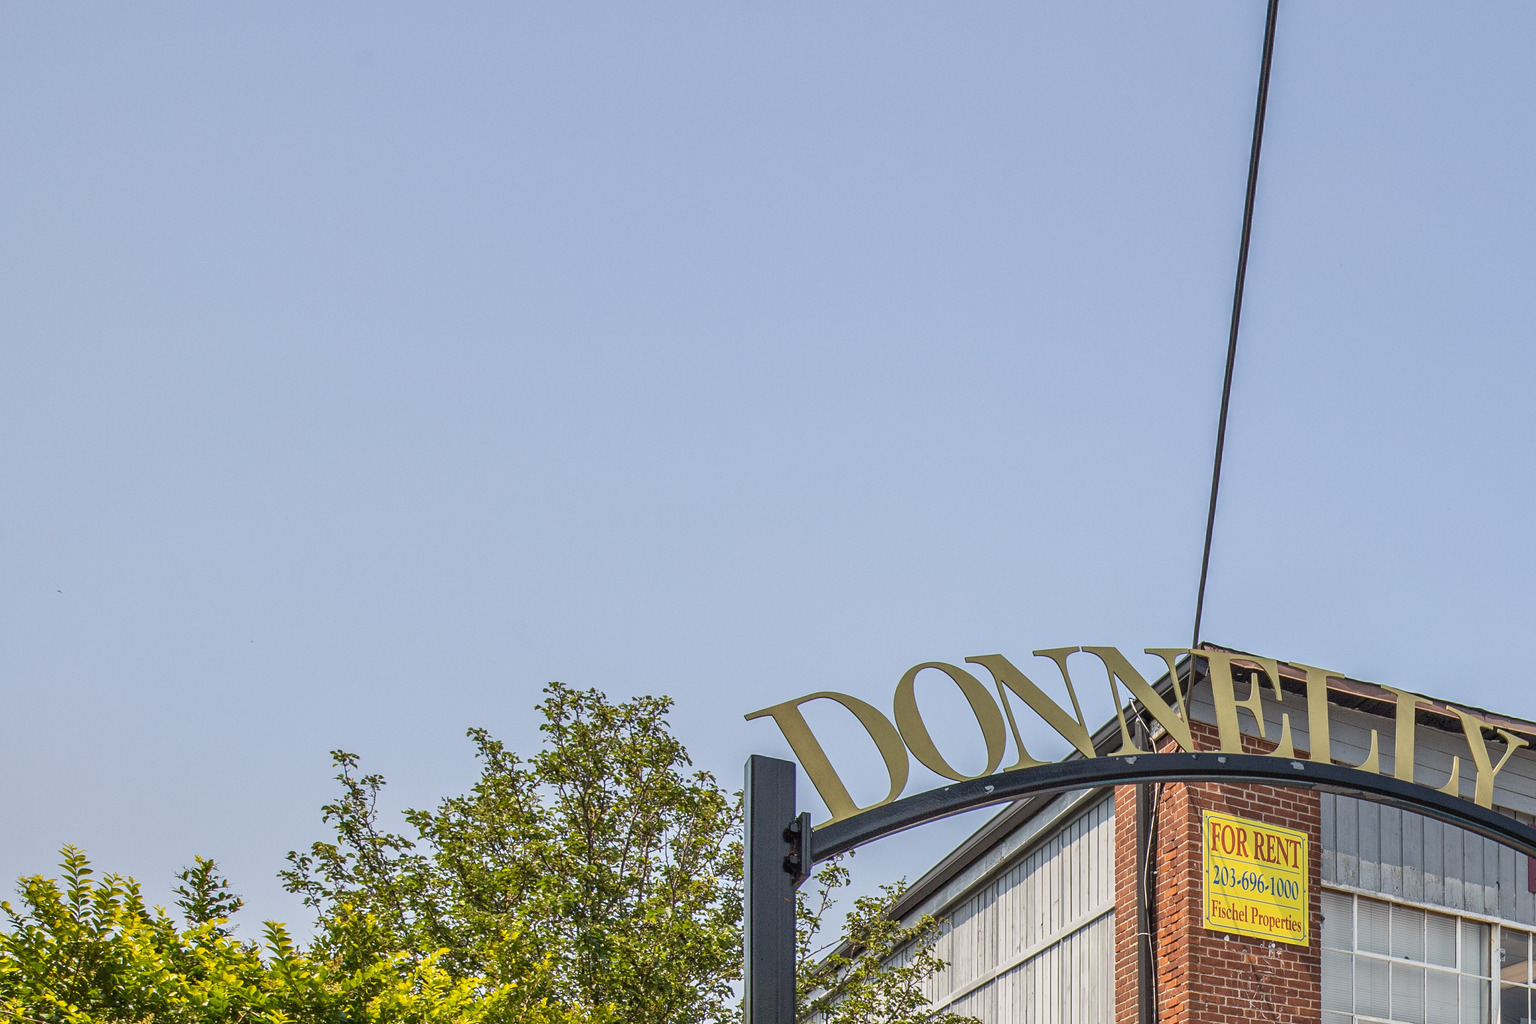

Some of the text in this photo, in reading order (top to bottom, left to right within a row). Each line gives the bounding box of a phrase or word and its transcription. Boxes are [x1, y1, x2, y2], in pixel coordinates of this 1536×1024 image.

[744, 646, 1529, 830] DONNELLY
[1210, 821, 1302, 869] FOR RENT
[1212, 864, 1299, 901] 203-696-1000
[1211, 899, 1302, 933] Fischel Properties
